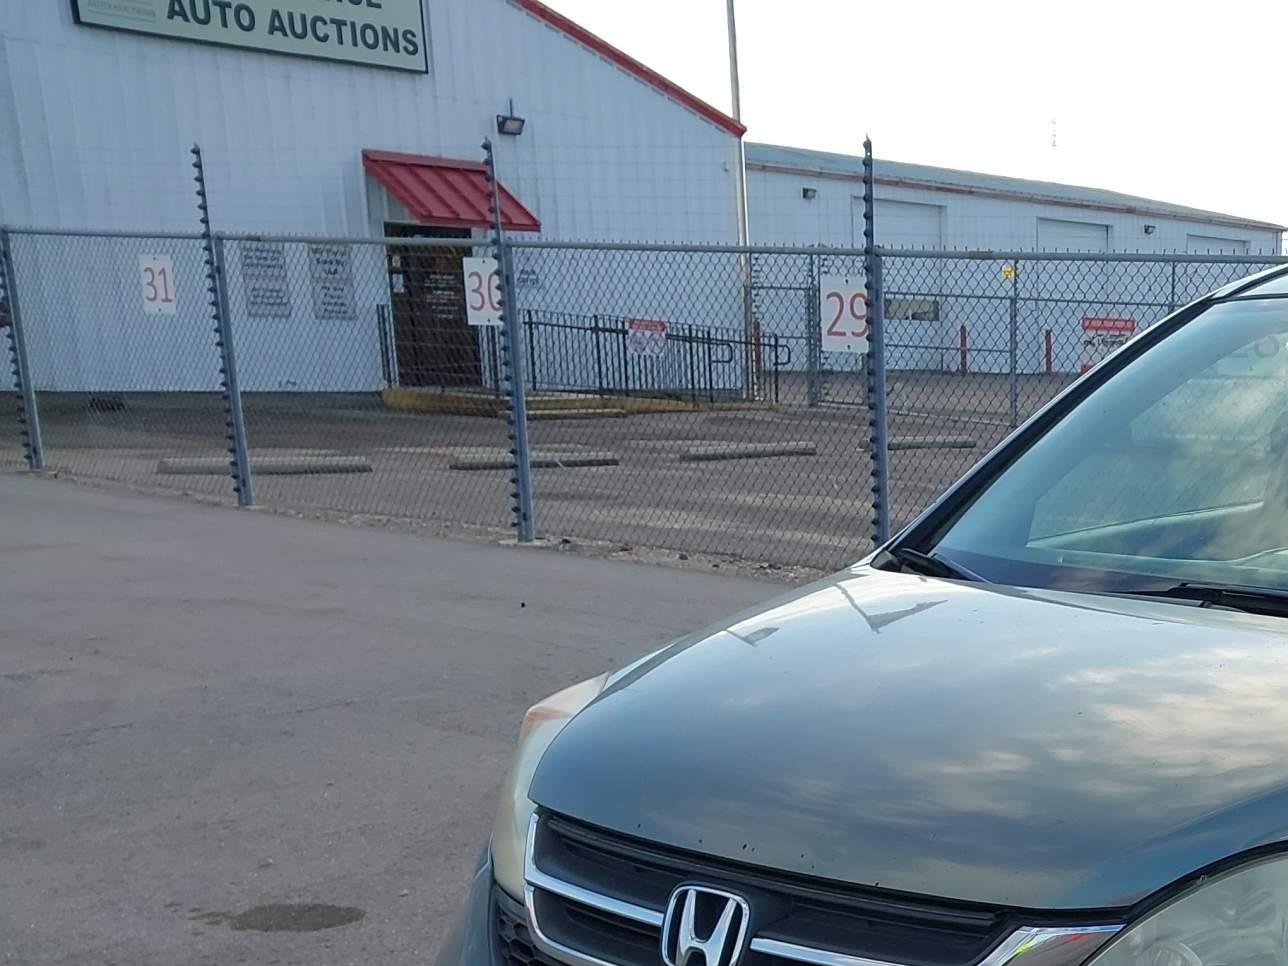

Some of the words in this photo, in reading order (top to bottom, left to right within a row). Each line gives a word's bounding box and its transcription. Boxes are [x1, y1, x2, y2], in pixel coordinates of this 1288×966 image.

[166, 0, 256, 32] AUTO
[268, 9, 419, 56] AUCTIONS
[144, 266, 172, 303] 31
[826, 291, 867, 337] 29
